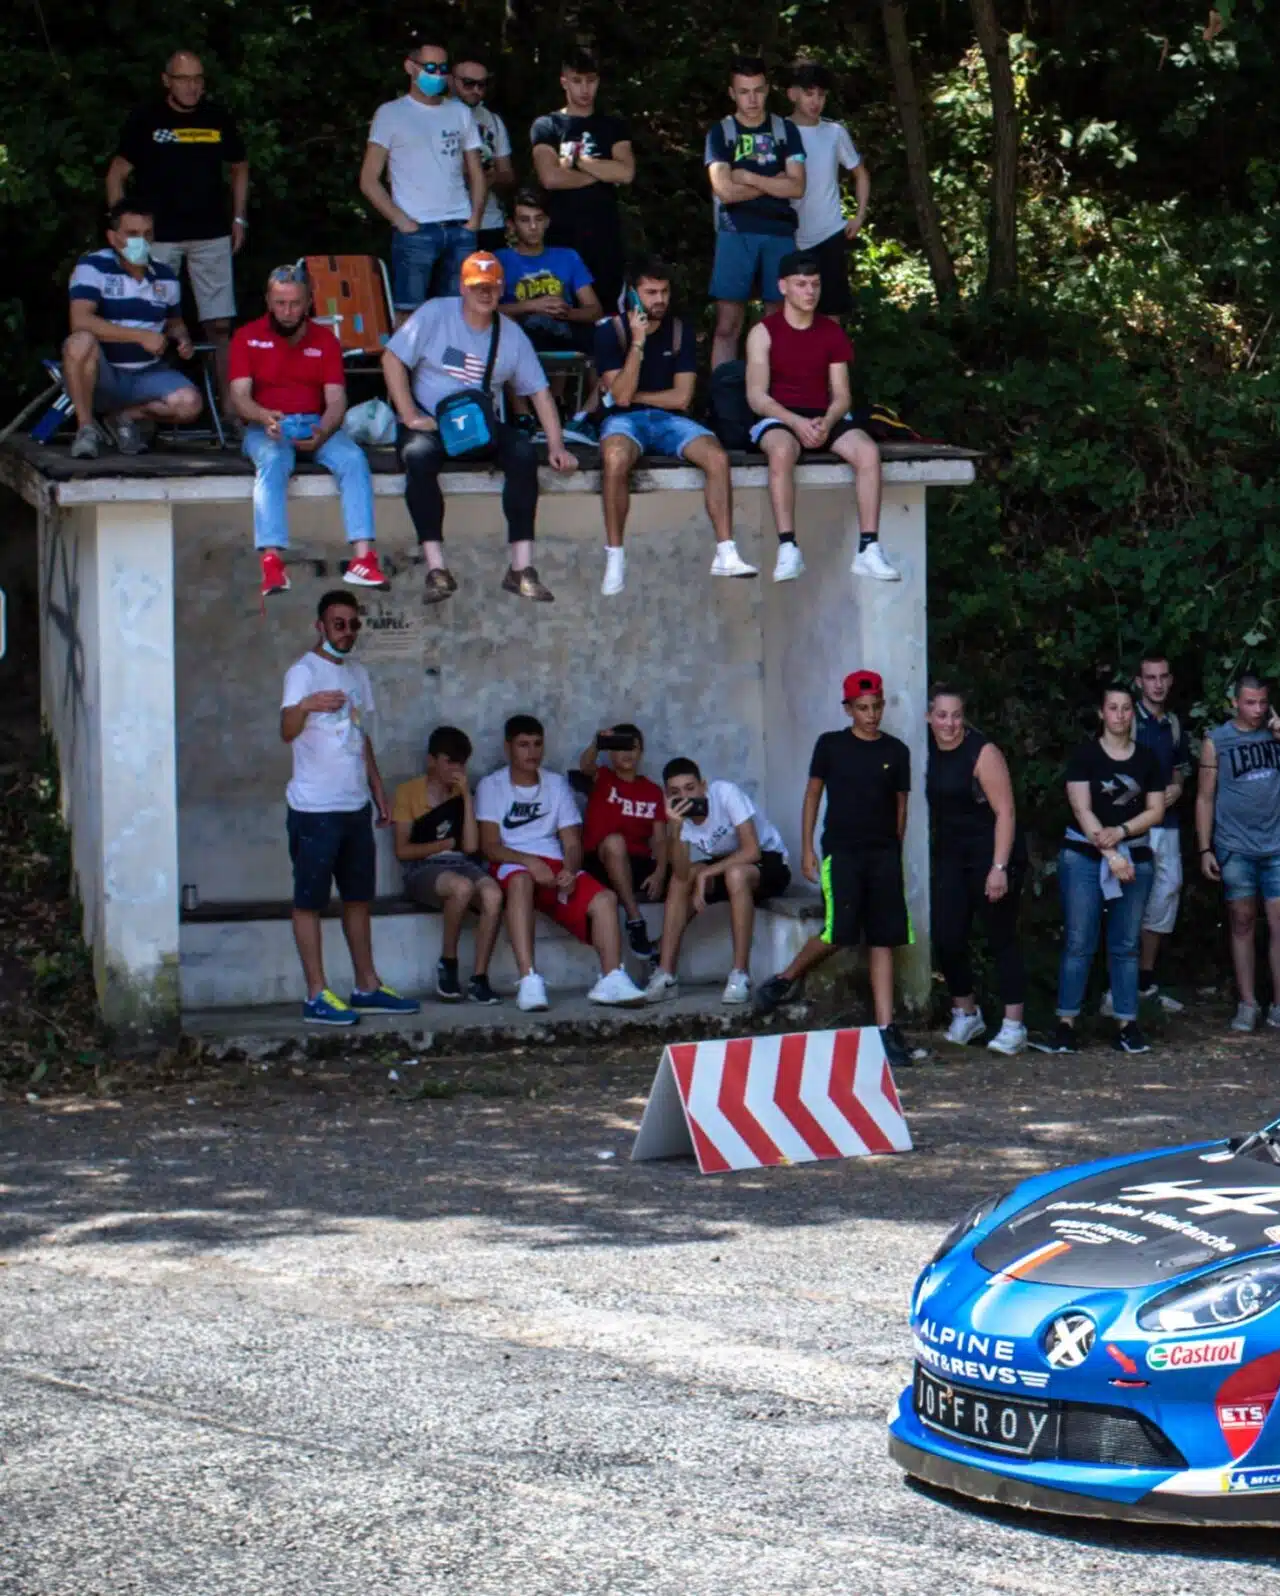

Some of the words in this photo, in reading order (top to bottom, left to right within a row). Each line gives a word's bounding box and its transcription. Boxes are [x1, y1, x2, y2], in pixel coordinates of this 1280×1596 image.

[510, 801, 542, 817] NIKE
[920, 1318, 1016, 1361] ALPINE
[1170, 1341, 1237, 1366] Castrol
[1221, 1405, 1264, 1422] ETS
